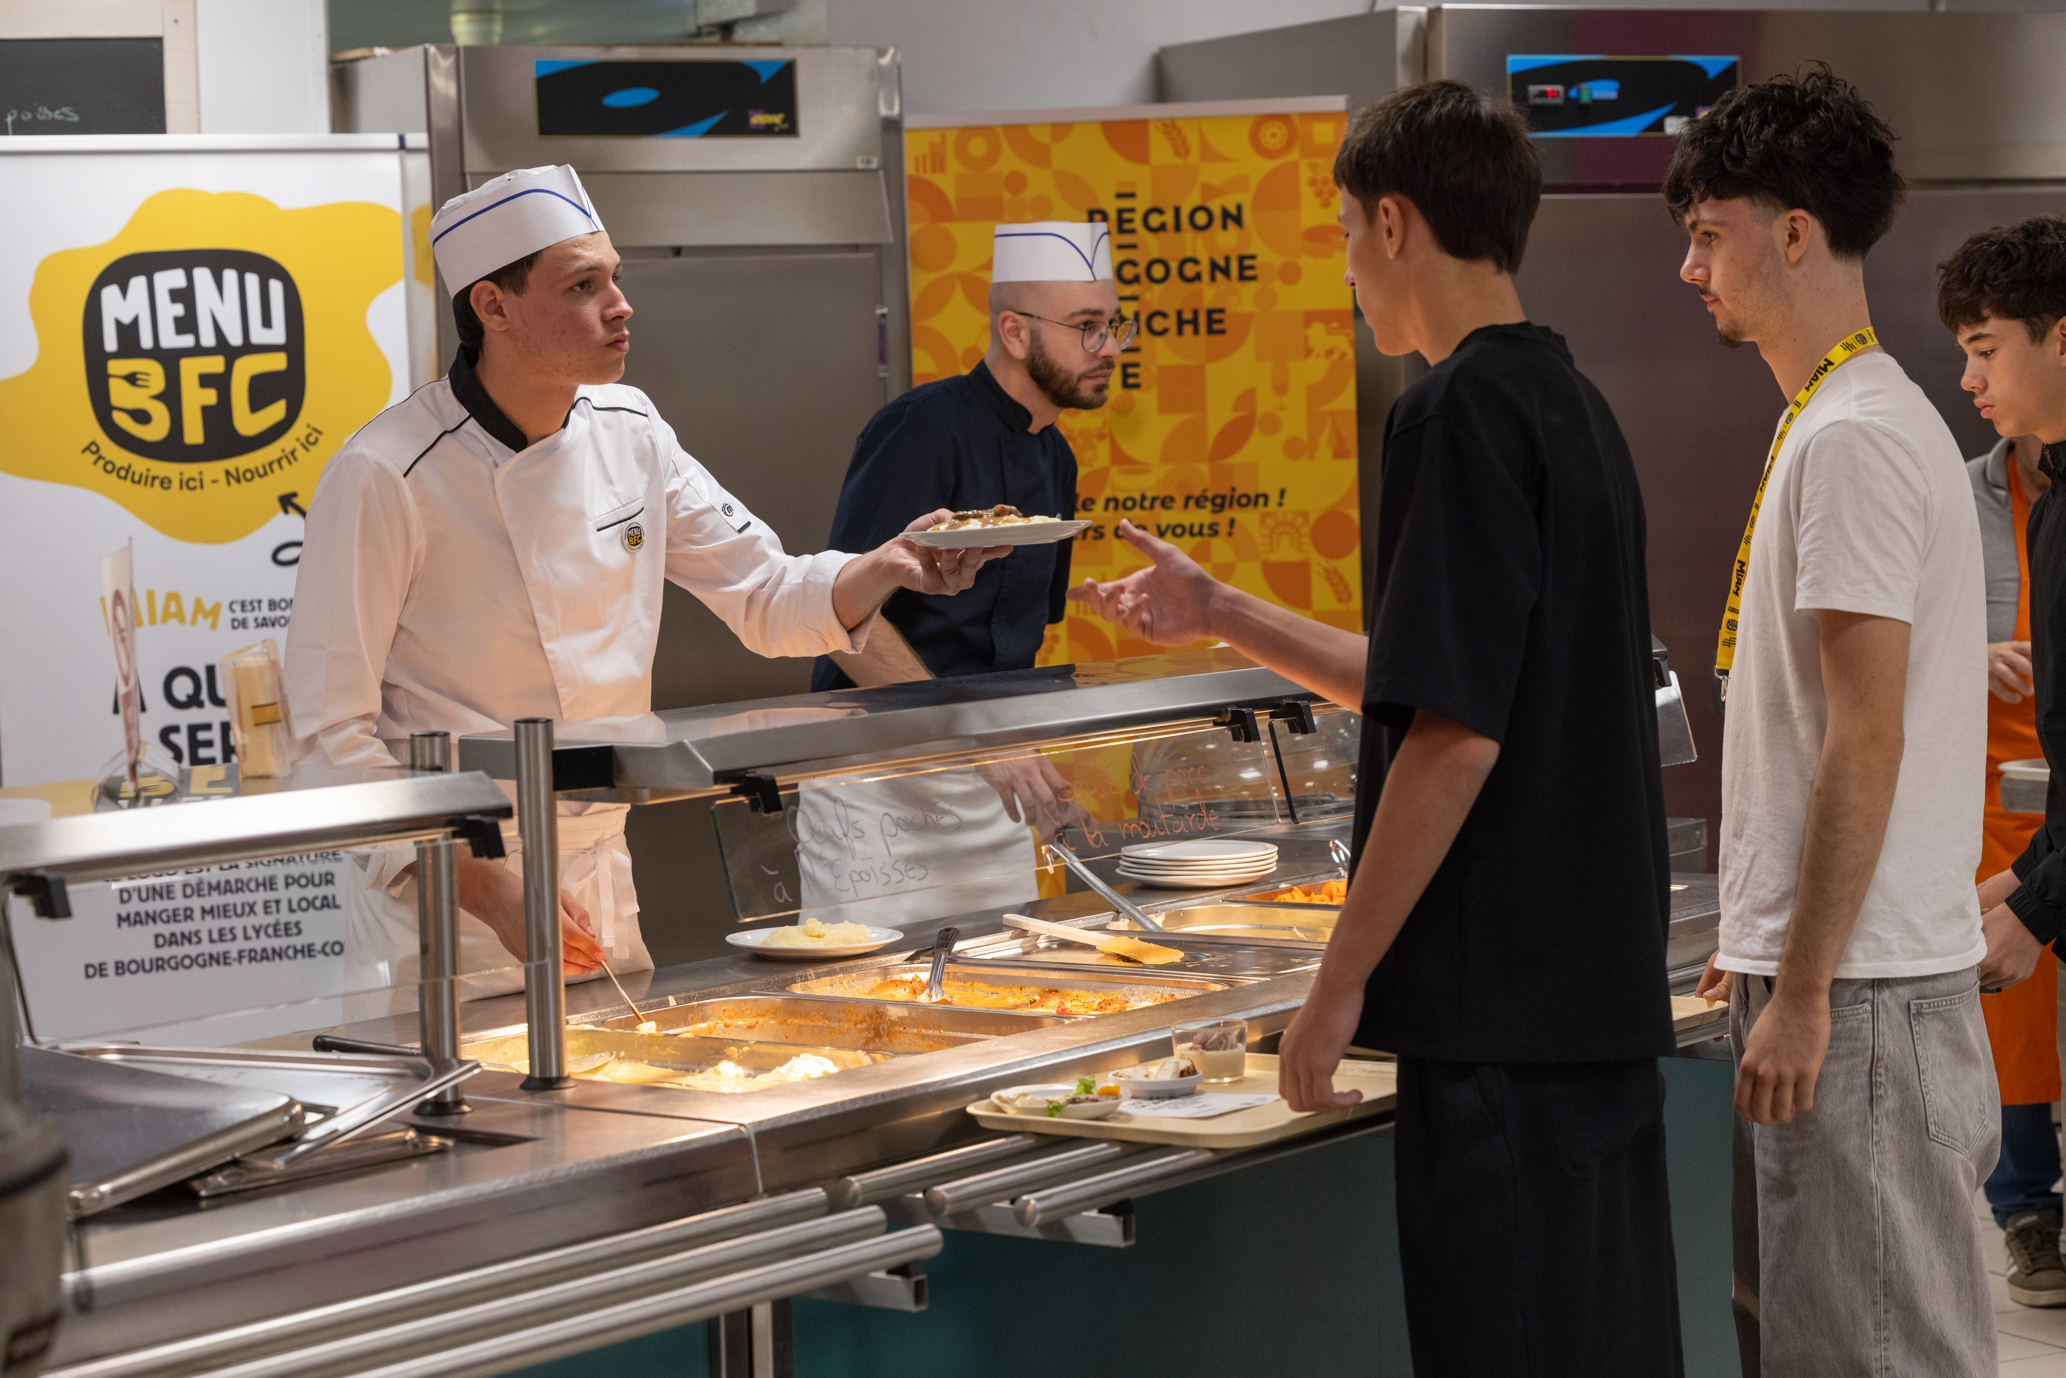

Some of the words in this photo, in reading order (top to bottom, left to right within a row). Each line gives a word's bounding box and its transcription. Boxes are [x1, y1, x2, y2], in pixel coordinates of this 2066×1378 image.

[1116, 255, 1259, 285] GOGNE
[101, 267, 286, 352] MENU
[1805, 357, 1835, 392] MIAM
[107, 352, 288, 445] BFC
[81, 440, 172, 490] Produire
[178, 471, 204, 491] ici
[224, 446, 299, 487] Nourrir
[299, 423, 323, 453] ici
[1104, 491, 1176, 513] notre
[1183, 485, 1269, 514] région
[628, 535, 642, 546] BFC
[1156, 519, 1220, 539] vous
[1733, 559, 1746, 597] MIAM
[228, 599, 263, 614] C'EST
[231, 616, 249, 631] DE
[253, 615, 290, 630] SAVO
[119, 882, 175, 905] D'UNE
[182, 874, 279, 899] DÉMARCHE
[284, 871, 336, 890] POUR
[117, 906, 194, 929] MANGER
[200, 901, 257, 921] MIEUX
[263, 898, 282, 916] ET
[287, 894, 341, 914] LOCAL
[154, 930, 202, 949] DANS
[208, 925, 238, 944] LES
[243, 918, 303, 942] LYCÉES
[84, 962, 108, 979] DE
[114, 940, 344, 977] BOURGOGNE-FRANCHE-CO
